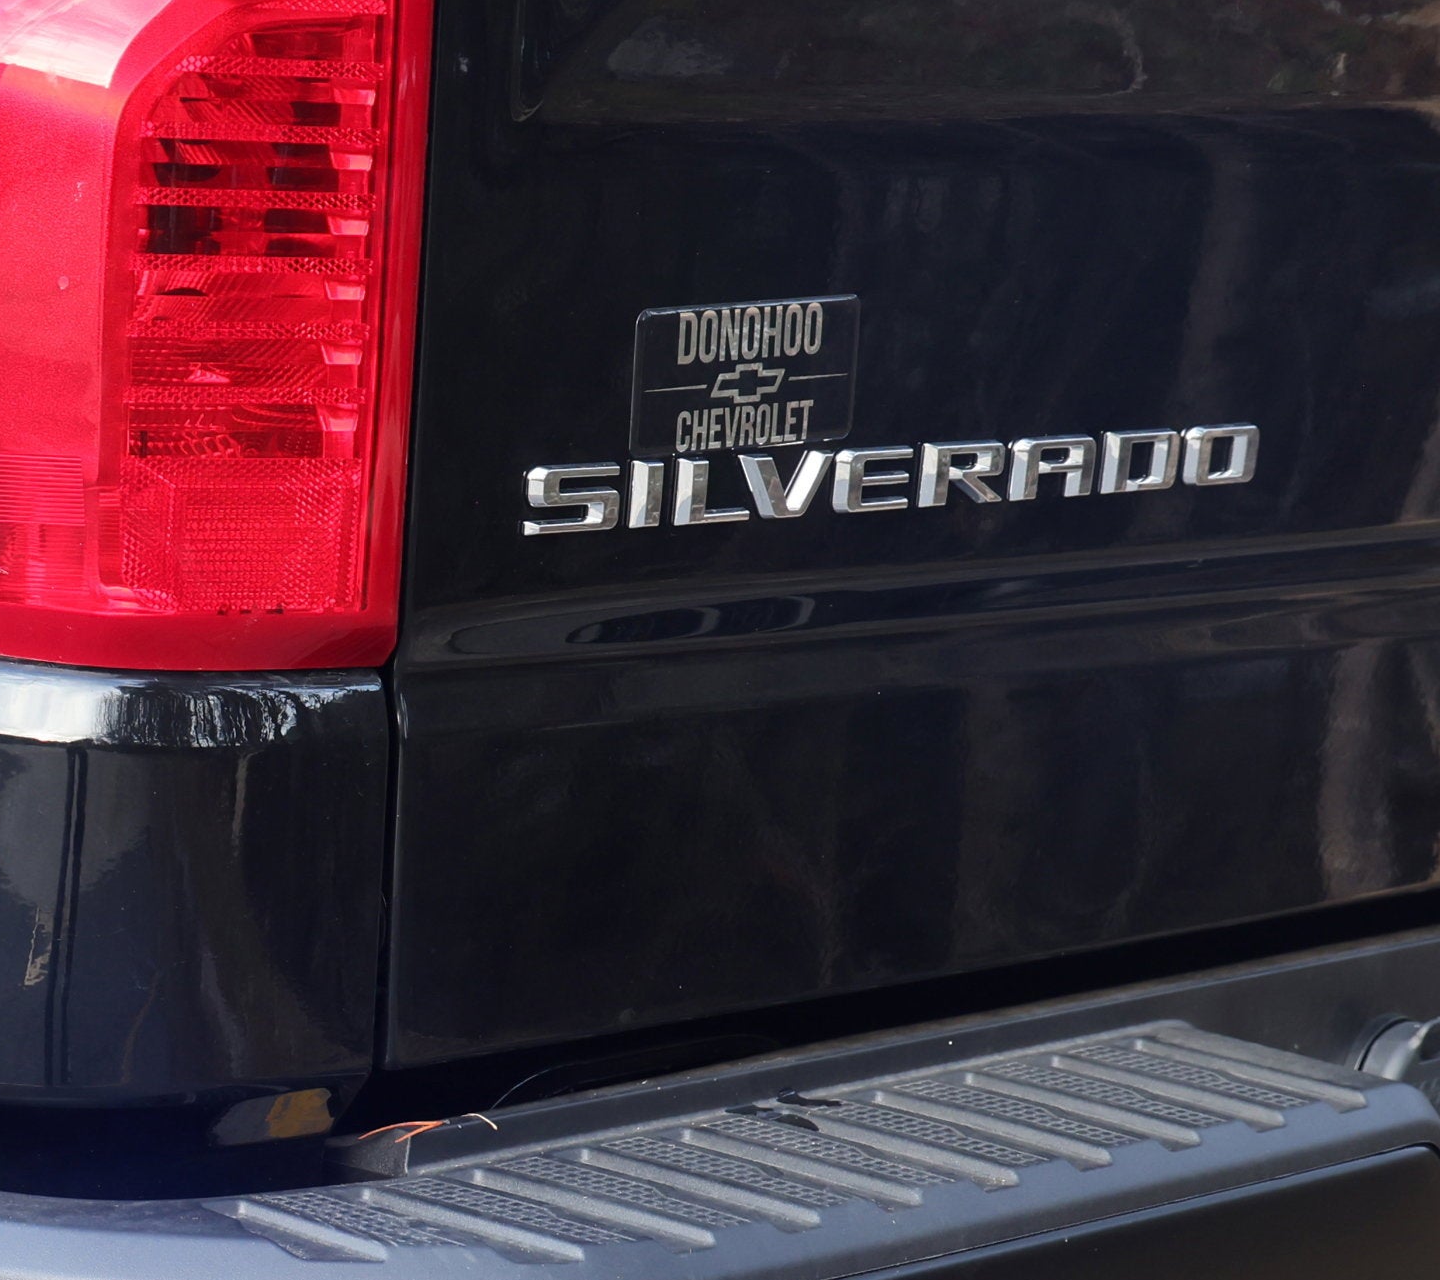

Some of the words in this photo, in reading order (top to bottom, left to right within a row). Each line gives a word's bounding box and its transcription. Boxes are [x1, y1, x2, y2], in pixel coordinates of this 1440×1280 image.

[677, 302, 824, 366] DONOHOO
[674, 399, 815, 453] CHEVROLET
[521, 422, 1260, 537] SILVERADO
